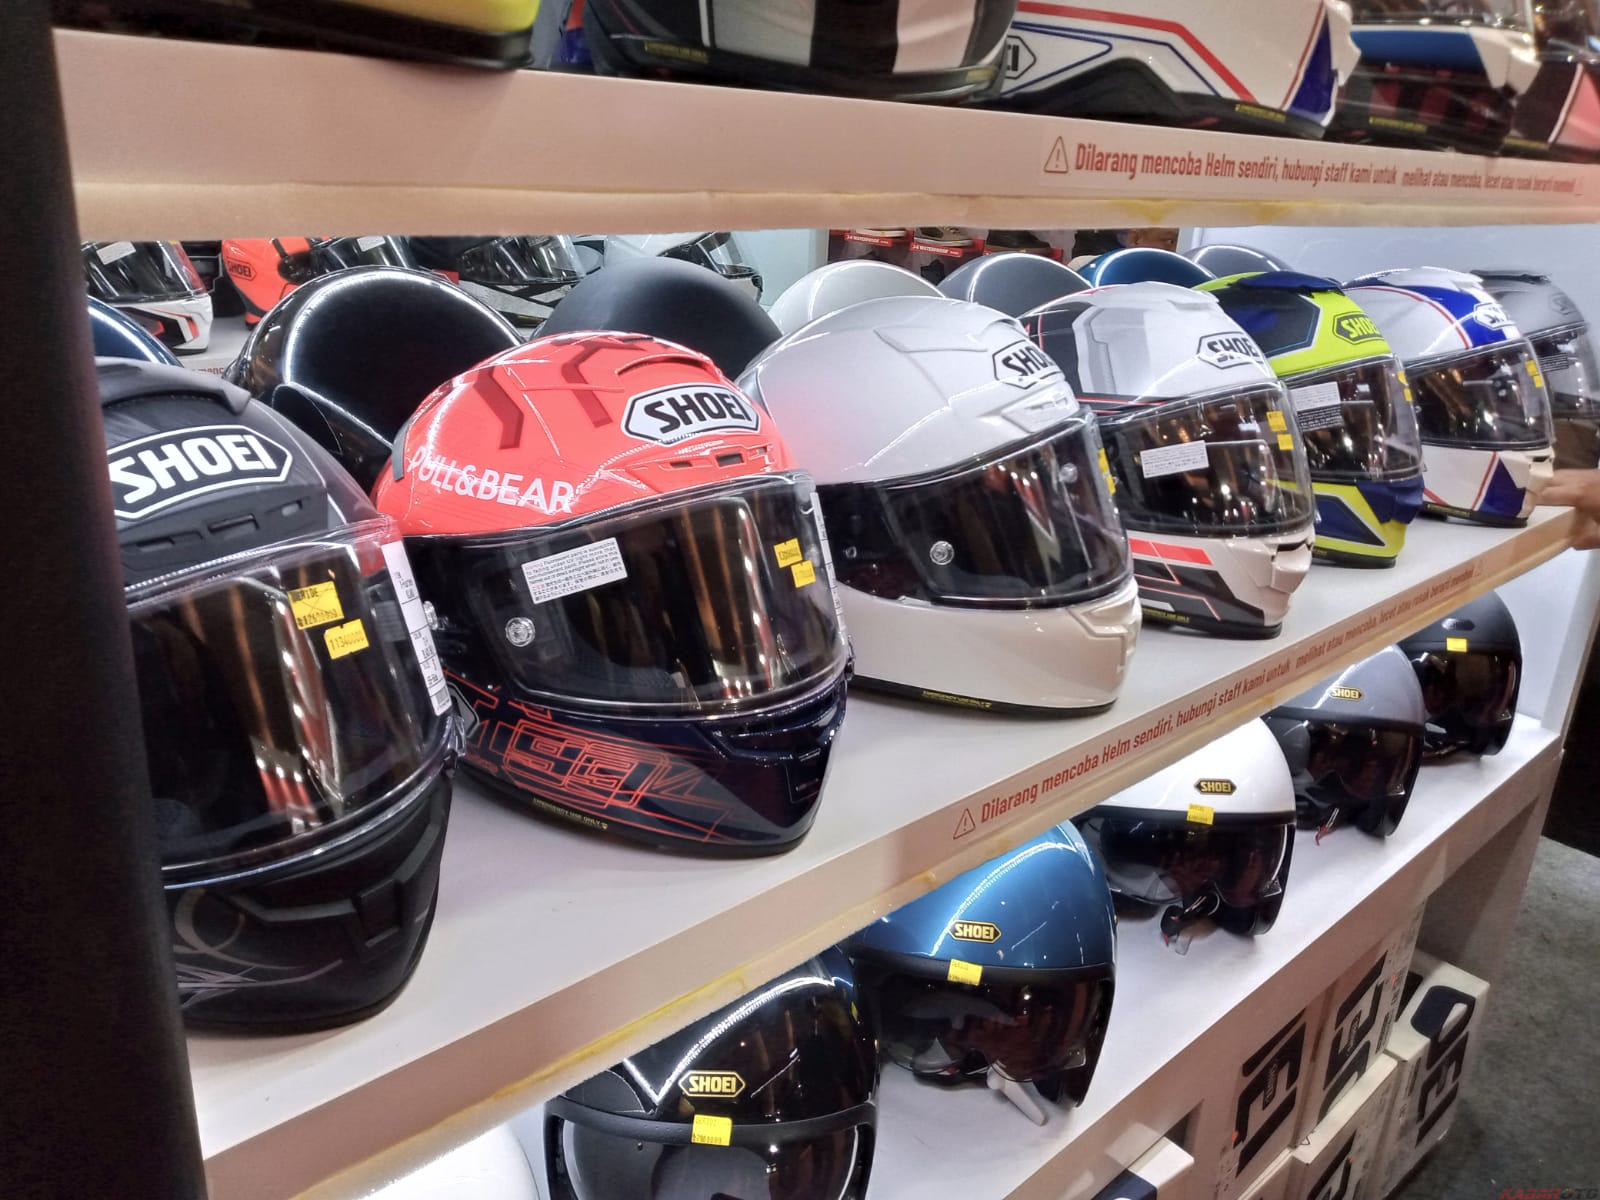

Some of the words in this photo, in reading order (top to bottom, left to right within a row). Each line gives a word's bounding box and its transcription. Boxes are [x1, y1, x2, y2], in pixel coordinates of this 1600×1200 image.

[1075, 143, 1138, 180] Dilarang
[1141, 151, 1202, 176] mencoba
[1205, 152, 1236, 178] Helm
[1237, 156, 1279, 183] sendiri,
[1282, 158, 1325, 187] hubungi
[1324, 162, 1349, 182] staff
[1350, 163, 1373, 184] kami
[1373, 166, 1397, 184] untuk
[643, 392, 752, 434] SHOEI
[108, 434, 278, 504] SHOEI
[406, 446, 576, 515] PULL&BEAR
[1331, 688, 1360, 699] SHOEI
[981, 783, 1038, 823] Dilarang
[1041, 754, 1099, 794] mencoba
[1101, 738, 1131, 764] Helm
[1133, 714, 1174, 749] sendiri,
[1176, 690, 1217, 727] hubungi
[1218, 683, 1242, 706] staff
[1242, 669, 1267, 695] kami
[1266, 659, 1292, 682] untuk
[1295, 645, 1325, 669] melihat
[1326, 635, 1344, 652] atau
[1200, 781, 1231, 793] SHOEI
[954, 923, 995, 940] SHOEI
[688, 1075, 737, 1093] SHOEI
